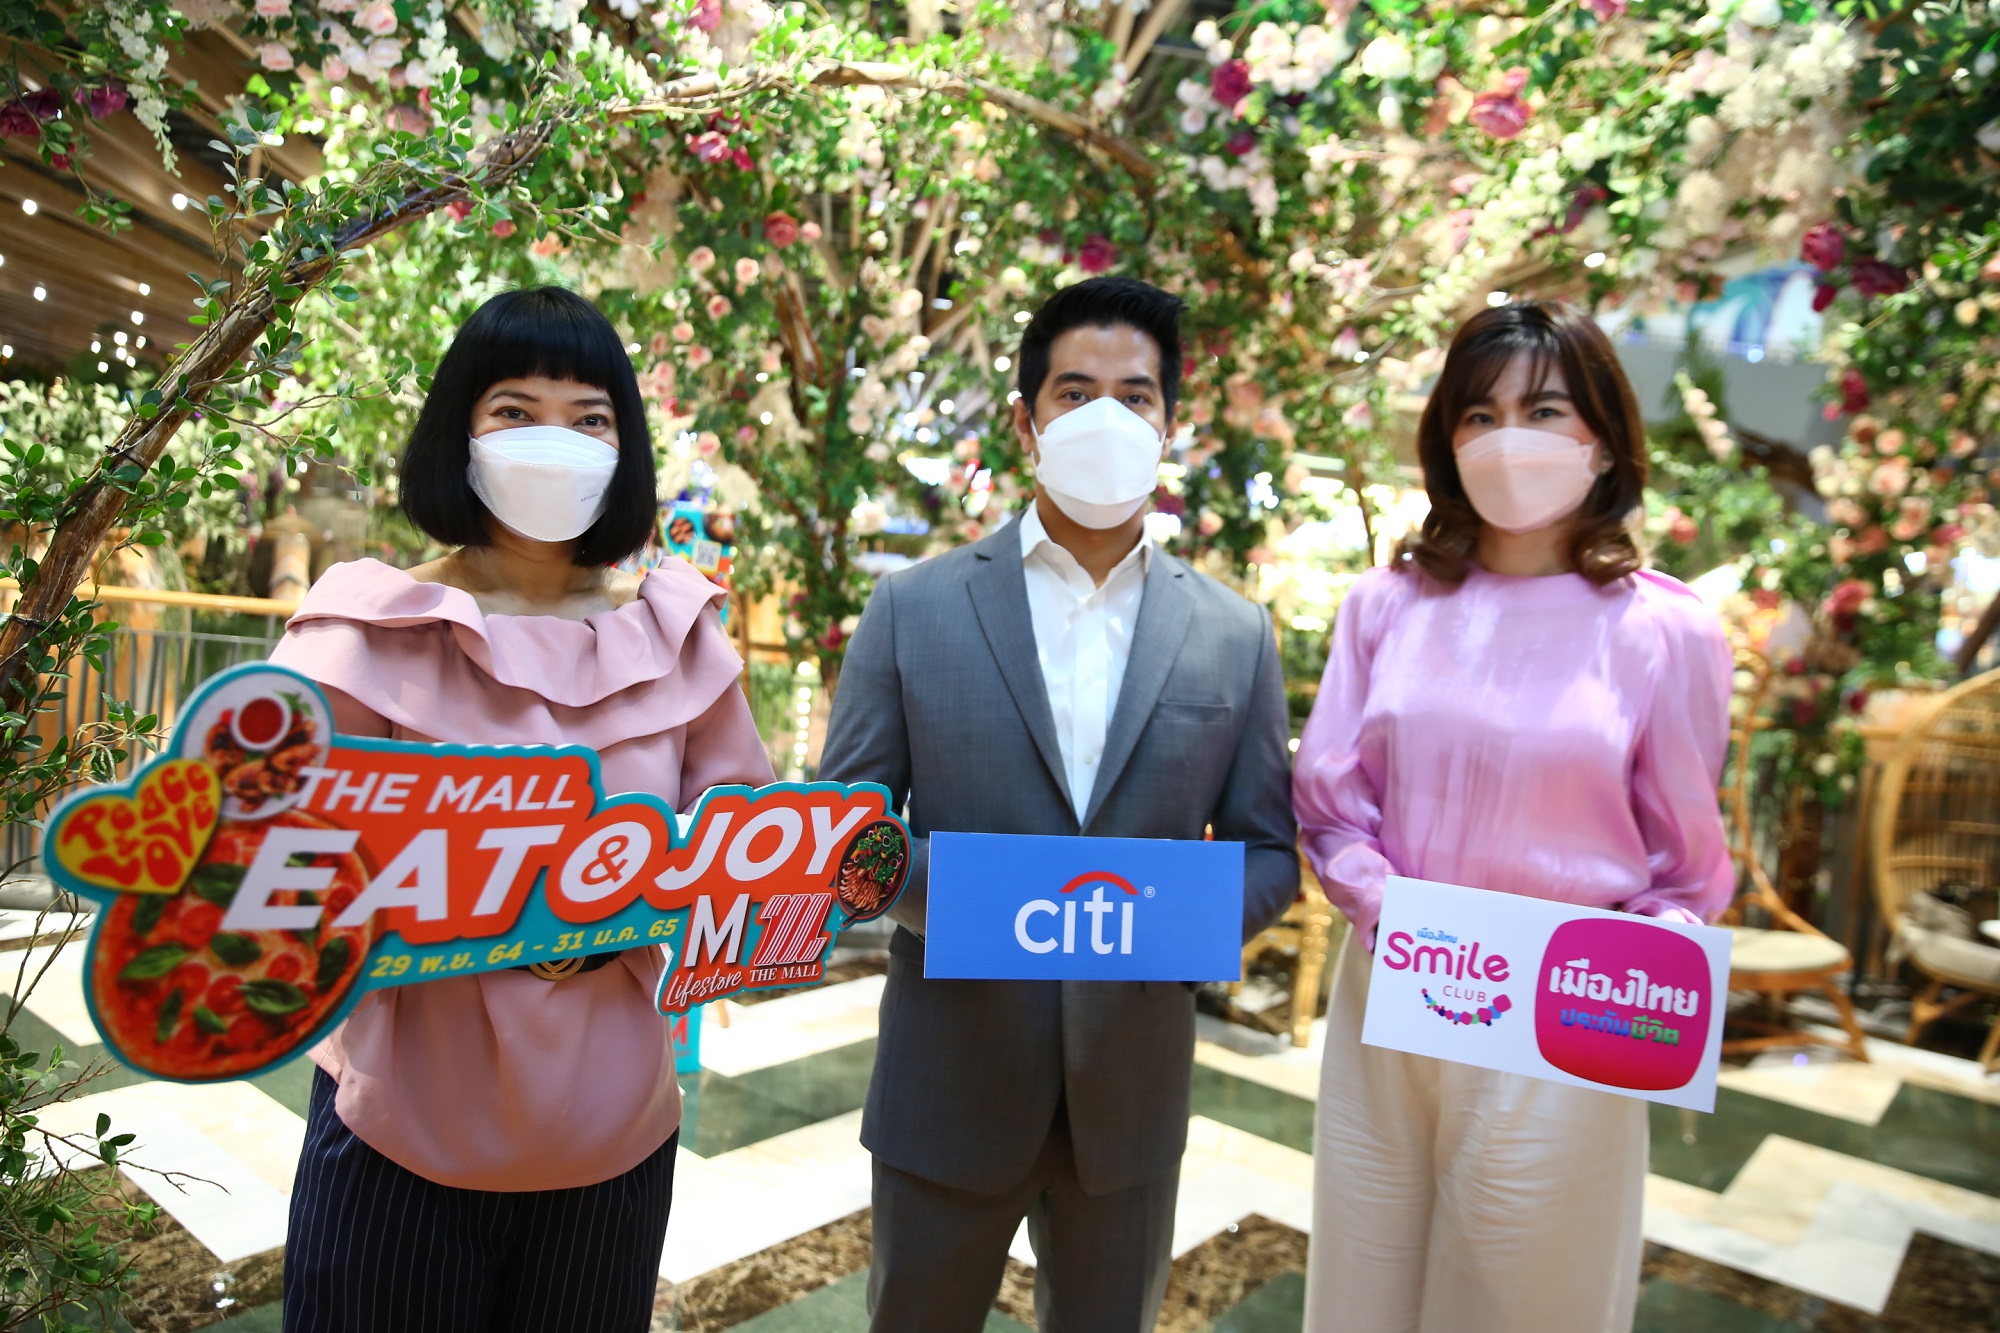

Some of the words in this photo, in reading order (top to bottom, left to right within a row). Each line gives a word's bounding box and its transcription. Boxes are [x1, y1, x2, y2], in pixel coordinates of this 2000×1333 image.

[297, 766, 418, 814] THE
[426, 774, 576, 813] MALL
[219, 824, 565, 931] EAT
[581, 835, 630, 885] &
[655, 806, 872, 891] JOY
[369, 955, 412, 978] 29
[419, 953, 475, 974] พ.ย.
[487, 941, 525, 965] 64
[552, 930, 583, 953] 31
[593, 926, 639, 947] ม.ค.
[648, 918, 680, 938] 65
[684, 893, 750, 967] M
[1416, 928, 1458, 943] เมืองไทย
[750, 967, 777, 982] THE
[781, 965, 819, 980] MALL
[1383, 931, 1510, 982] Smile
[666, 968, 743, 1007] Lifestore
[1442, 985, 1487, 1003] CLUB
[1549, 958, 1699, 1017] เมืองไทย
